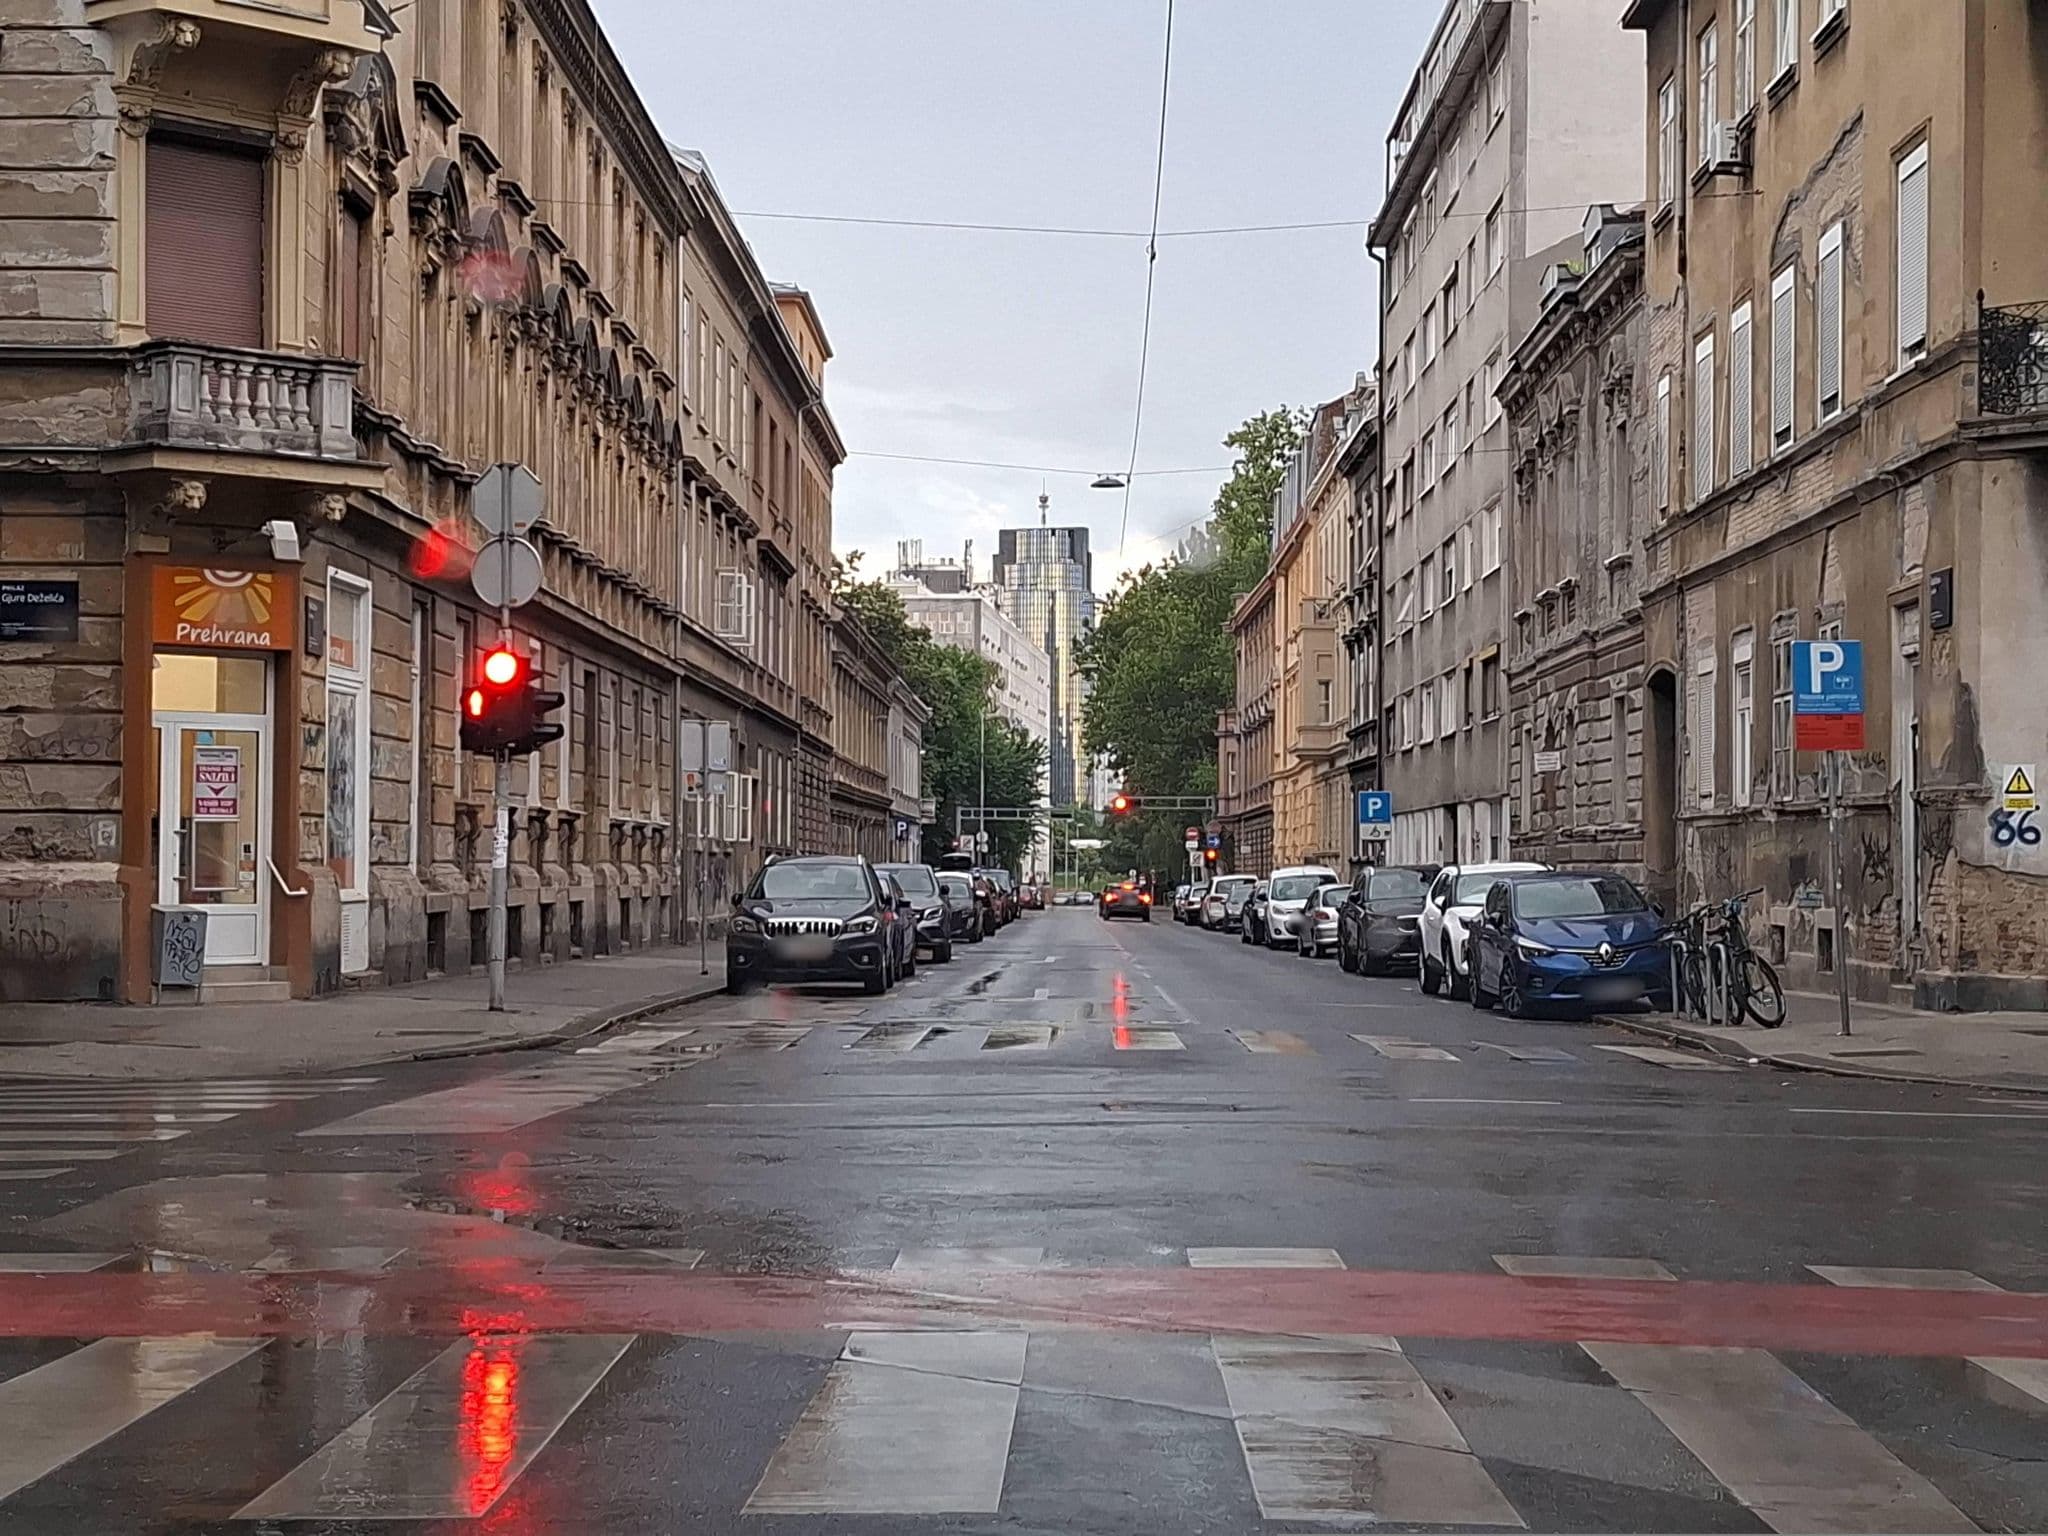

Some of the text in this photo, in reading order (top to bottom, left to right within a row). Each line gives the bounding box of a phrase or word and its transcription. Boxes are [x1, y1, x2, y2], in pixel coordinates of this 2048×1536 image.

[1, 593, 26, 604] Gjure
[176, 623, 271, 646] Prehrana
[1810, 643, 1844, 694] P
[1368, 797, 1382, 818] P
[897, 821, 907, 837] P
